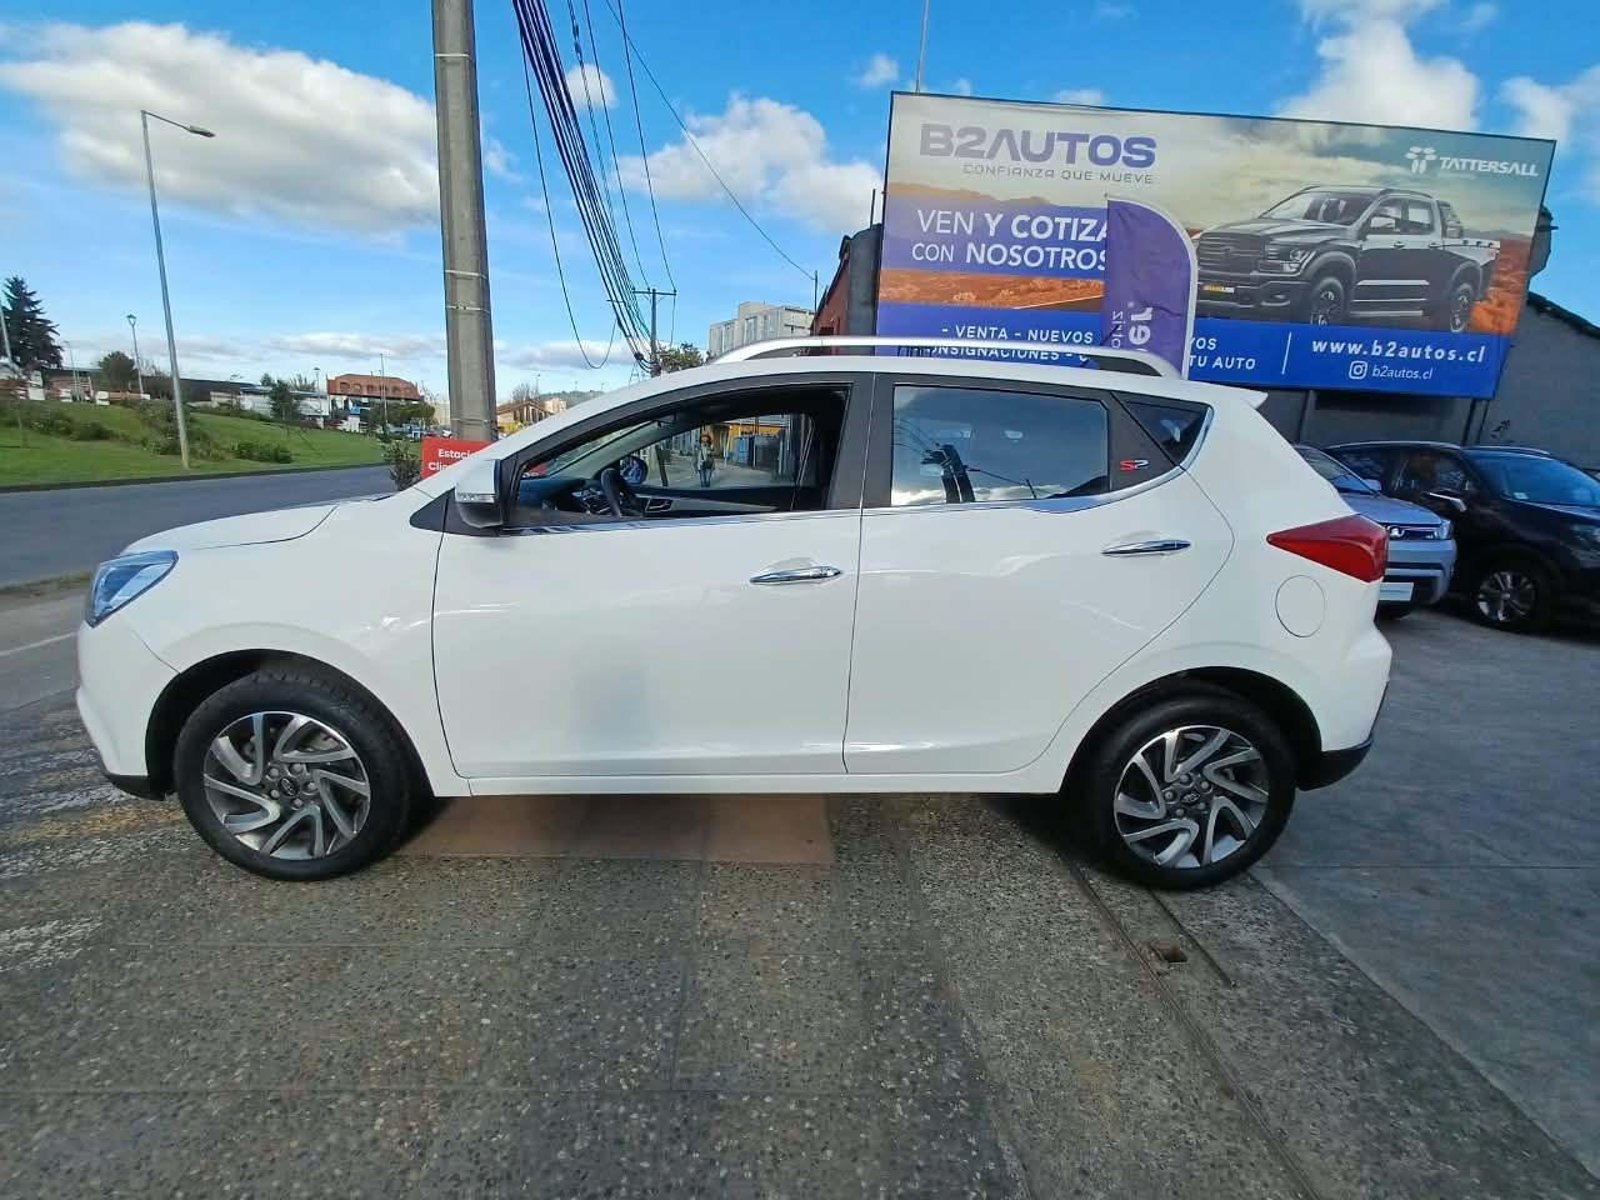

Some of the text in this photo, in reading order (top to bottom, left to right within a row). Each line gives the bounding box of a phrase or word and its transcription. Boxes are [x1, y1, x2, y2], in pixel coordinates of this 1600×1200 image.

[920, 123, 1157, 168] B2AUTOS
[963, 164, 1154, 184] CONFIANZA QUE MUEVE
[1440, 157, 1539, 177] TATTERSALL
[917, 209, 974, 235] VEN
[984, 212, 1004, 237] Y
[912, 243, 954, 262] CON
[955, 325, 1008, 340] VENTA
[1027, 329, 1094, 344] NUEVOS
[1190, 337, 1217, 350] OS
[1311, 340, 1486, 363] www.b2autos.cl
[1212, 356, 1256, 370] AUTO
[1372, 365, 1433, 380] b2autos.cl
